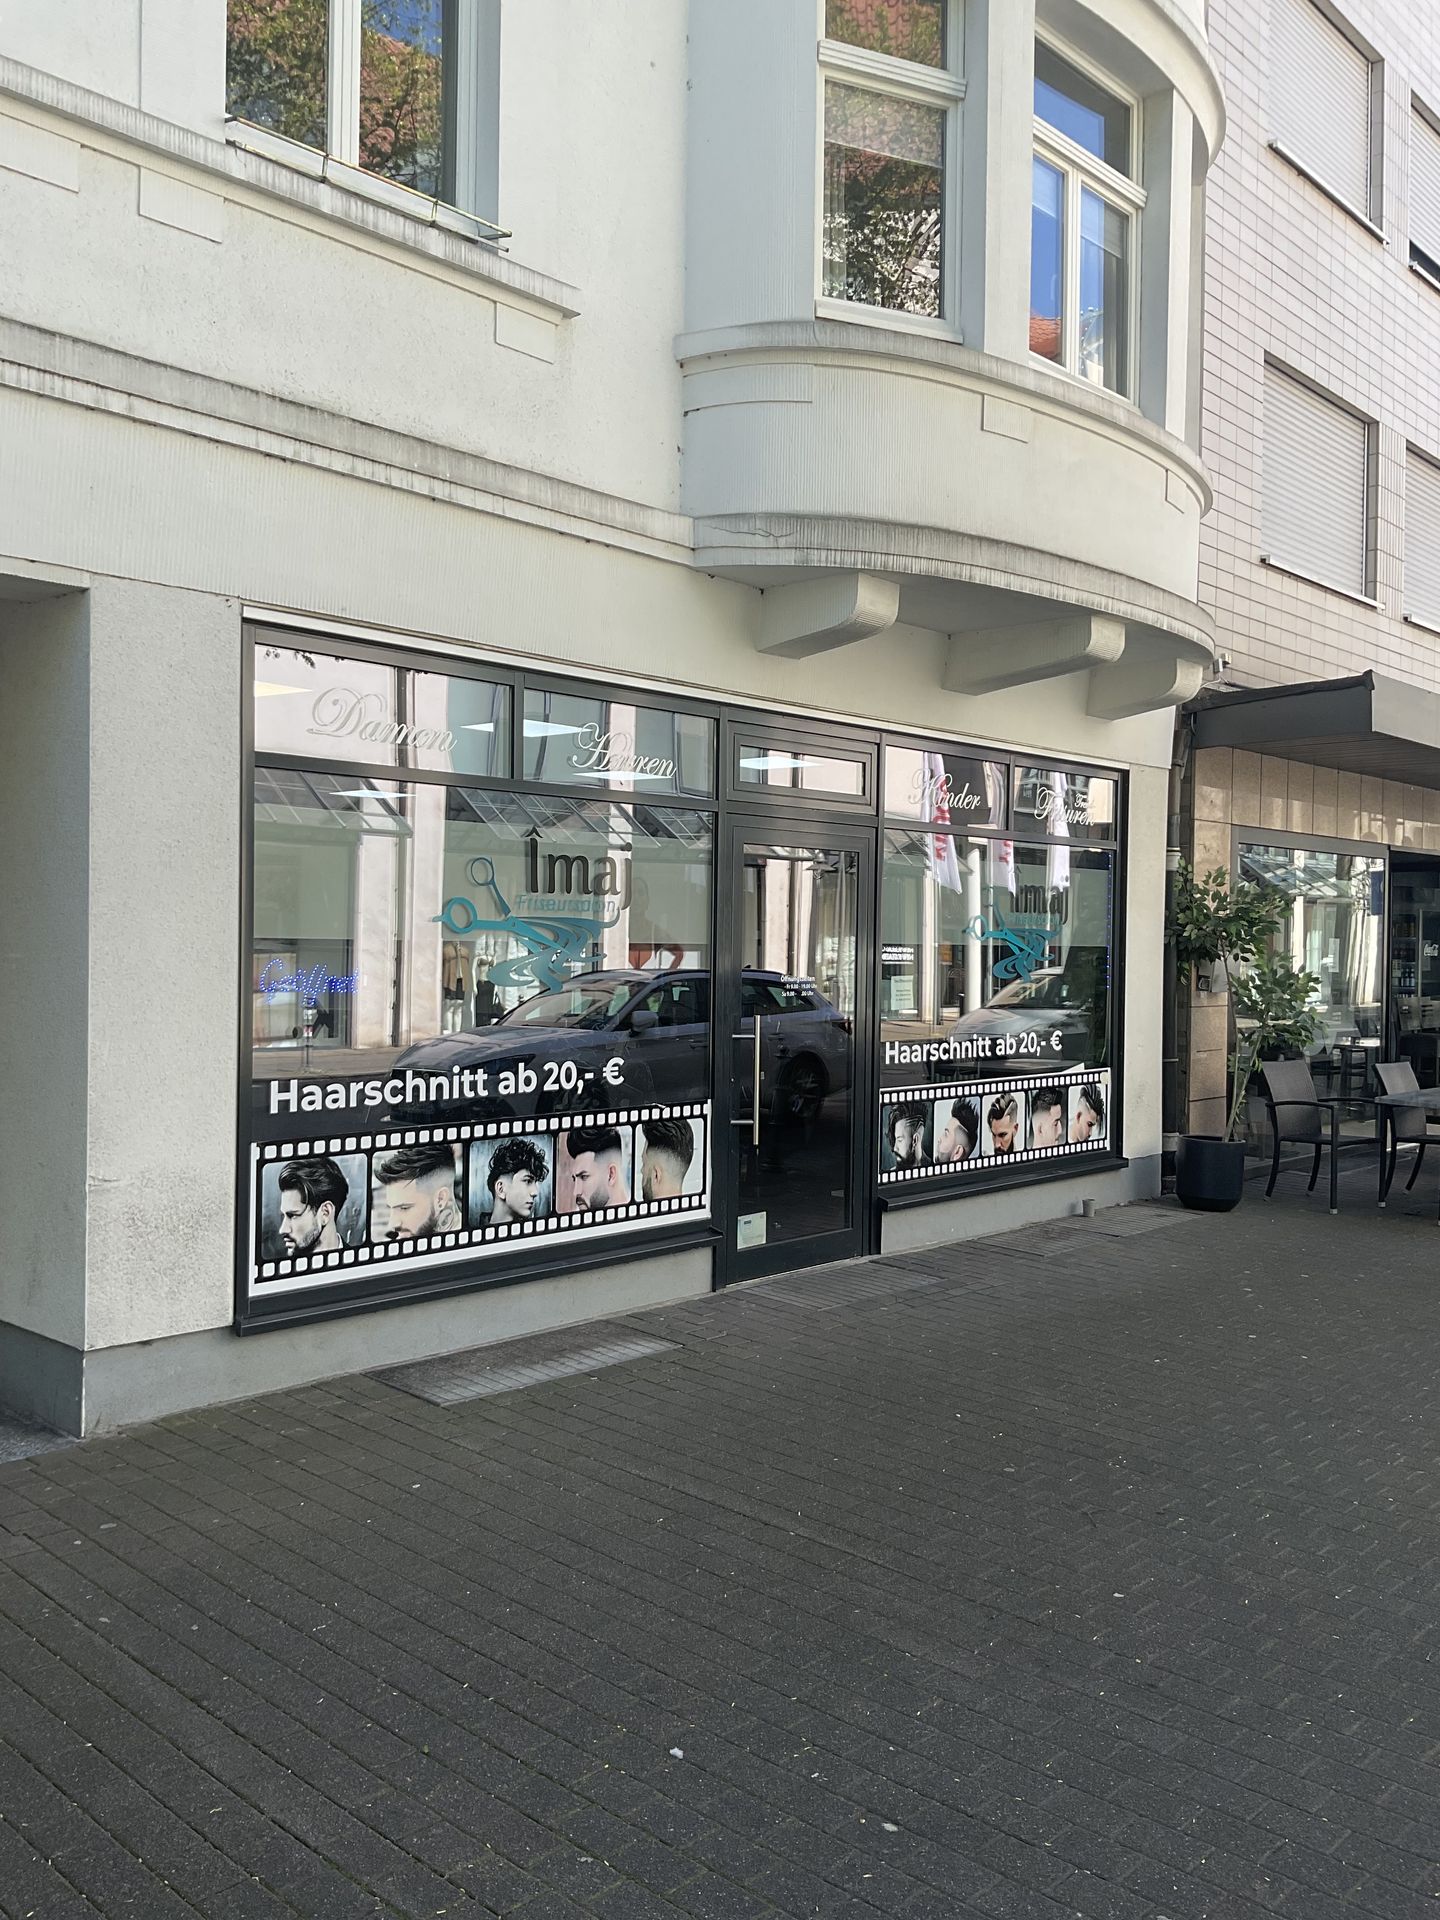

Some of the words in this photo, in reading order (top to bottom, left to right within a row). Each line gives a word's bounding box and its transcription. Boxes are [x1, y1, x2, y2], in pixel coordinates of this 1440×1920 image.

[306, 687, 457, 752] Damen
[572, 722, 677, 777] Herren
[908, 768, 981, 810] Kinder
[1074, 793, 1096, 809] Tred
[885, 1034, 992, 1064] Haarschnitt
[995, 1033, 1017, 1056] ab
[1019, 1032, 1047, 1056] 20,-
[1050, 1030, 1063, 1050] €
[270, 1065, 489, 1114] Haarschnitt
[499, 1062, 538, 1095] ab
[543, 1060, 594, 1095] 20,-
[602, 1056, 625, 1086] €
